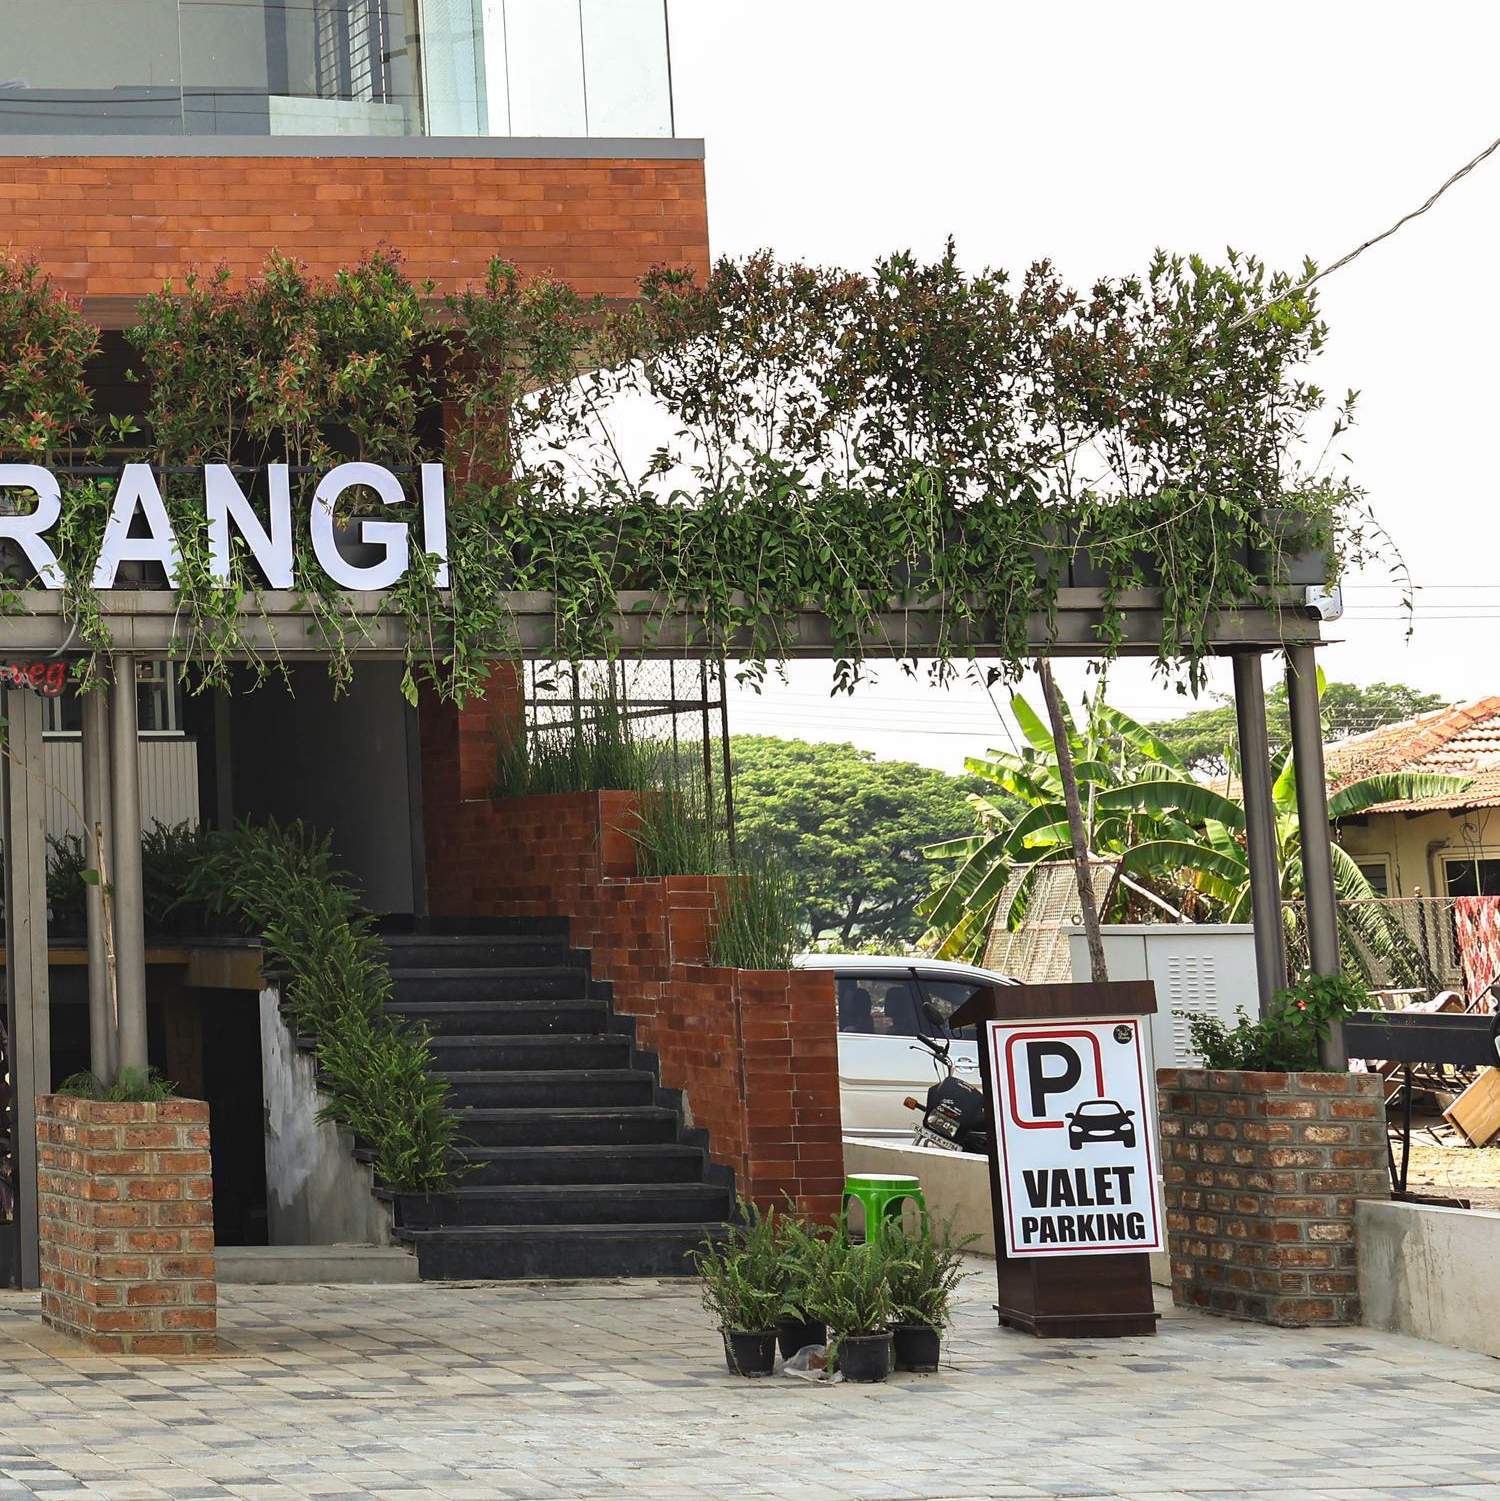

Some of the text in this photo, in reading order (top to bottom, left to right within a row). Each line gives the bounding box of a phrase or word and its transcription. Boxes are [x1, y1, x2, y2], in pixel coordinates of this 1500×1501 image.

[1026, 1040, 1082, 1118] P
[1022, 1166, 1135, 1209] VALET
[1021, 1211, 1146, 1244] PARKING
